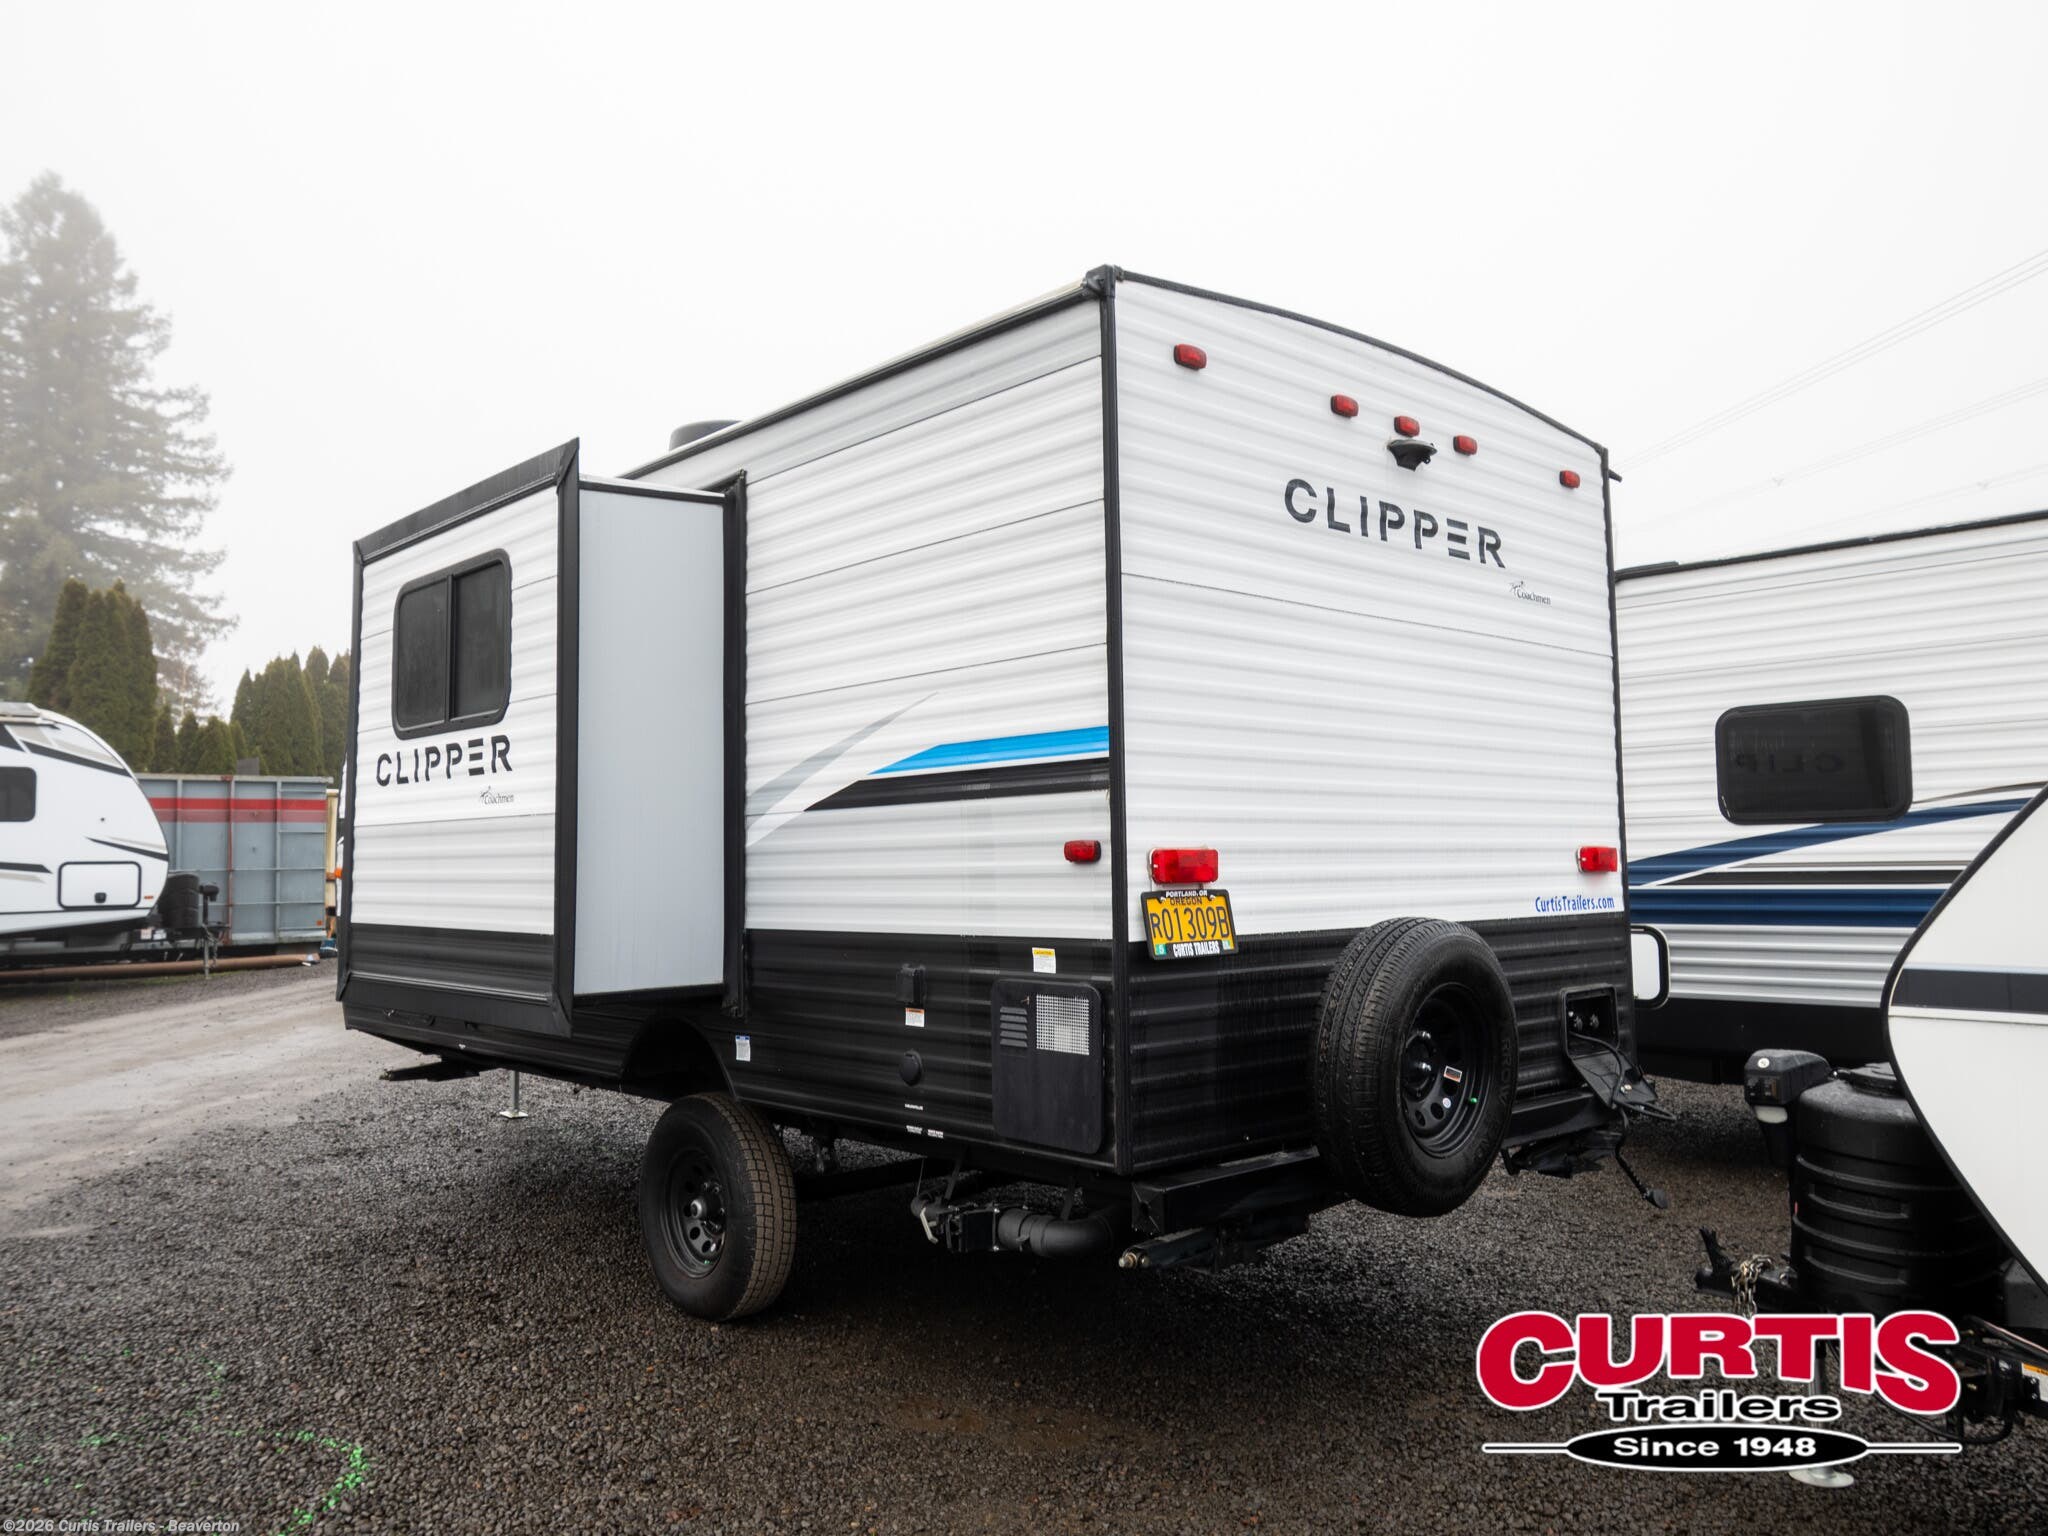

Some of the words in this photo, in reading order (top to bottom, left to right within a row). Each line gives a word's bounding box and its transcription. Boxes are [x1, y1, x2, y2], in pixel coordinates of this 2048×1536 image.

[1284, 478, 1505, 568] CLIPPER
[1516, 587, 1551, 604] Coachmen
[376, 735, 513, 787] CLIPPER
[1170, 897, 1203, 906] OREGON
[1535, 894, 1615, 912] CurtisTrailers.com
[1149, 906, 1230, 941] R01309B
[1172, 942, 1195, 957] CURTIS
[1193, 940, 1221, 956] TRAILERS
